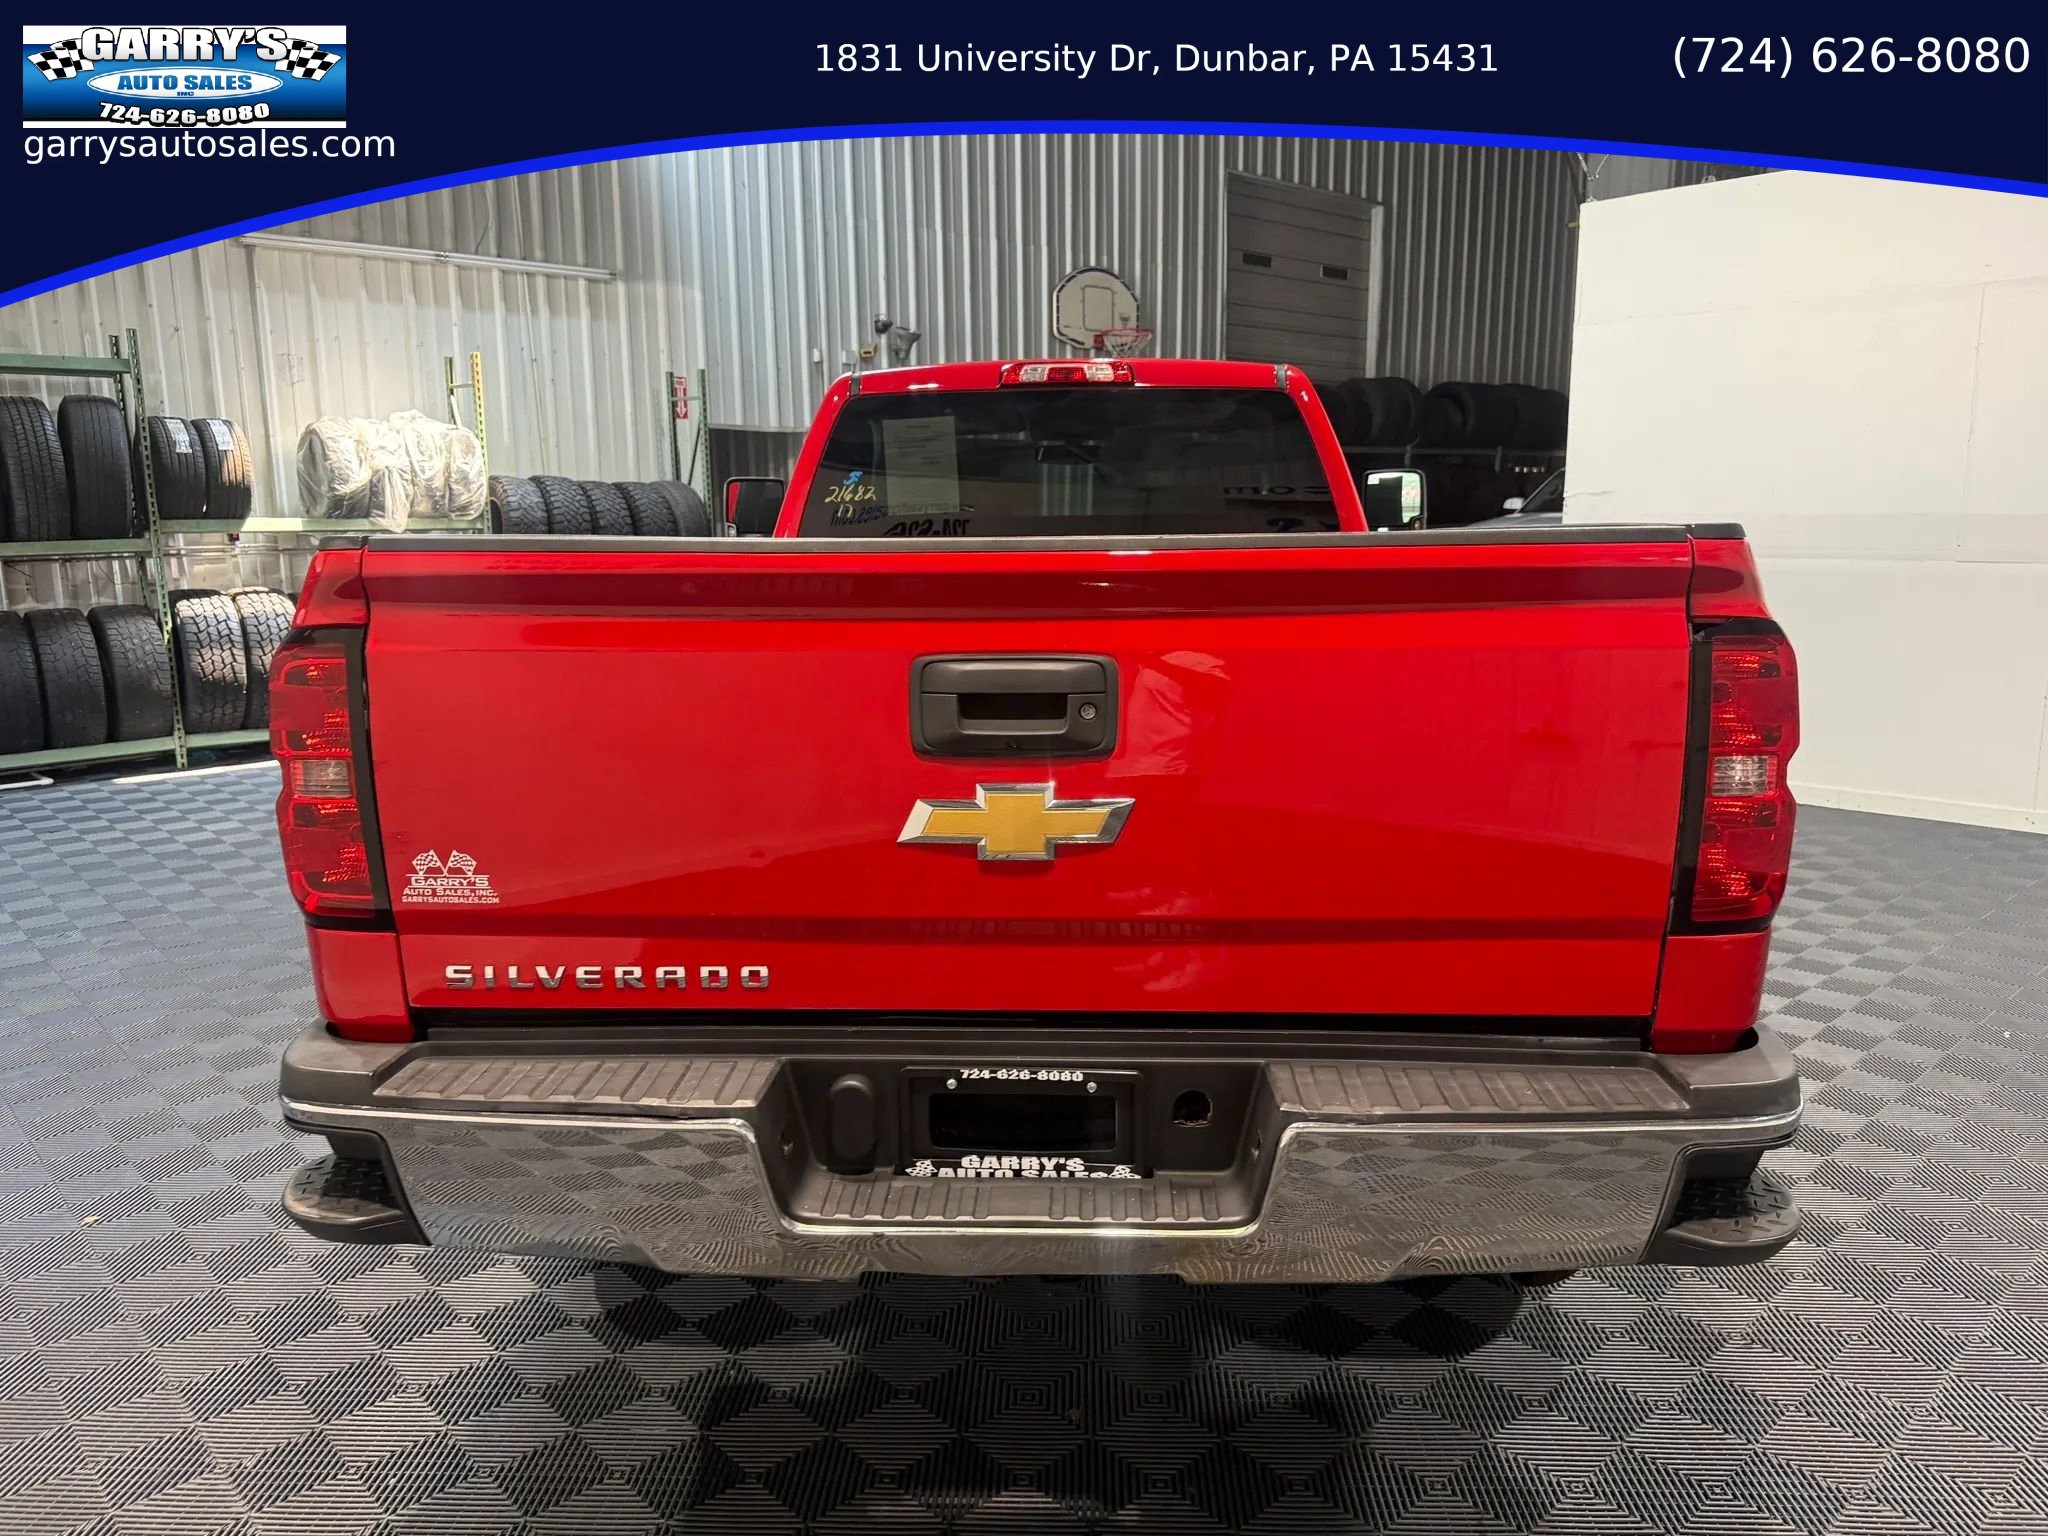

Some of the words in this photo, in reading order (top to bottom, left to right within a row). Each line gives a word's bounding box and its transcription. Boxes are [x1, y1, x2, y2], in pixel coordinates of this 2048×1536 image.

[410, 876, 489, 887] GARRY'S
[403, 887, 433, 896] AUTO
[445, 964, 770, 990] SILVERADO
[960, 1068, 1084, 1082] 724-626-8080
[961, 1155, 1085, 1172] GARRY'S
